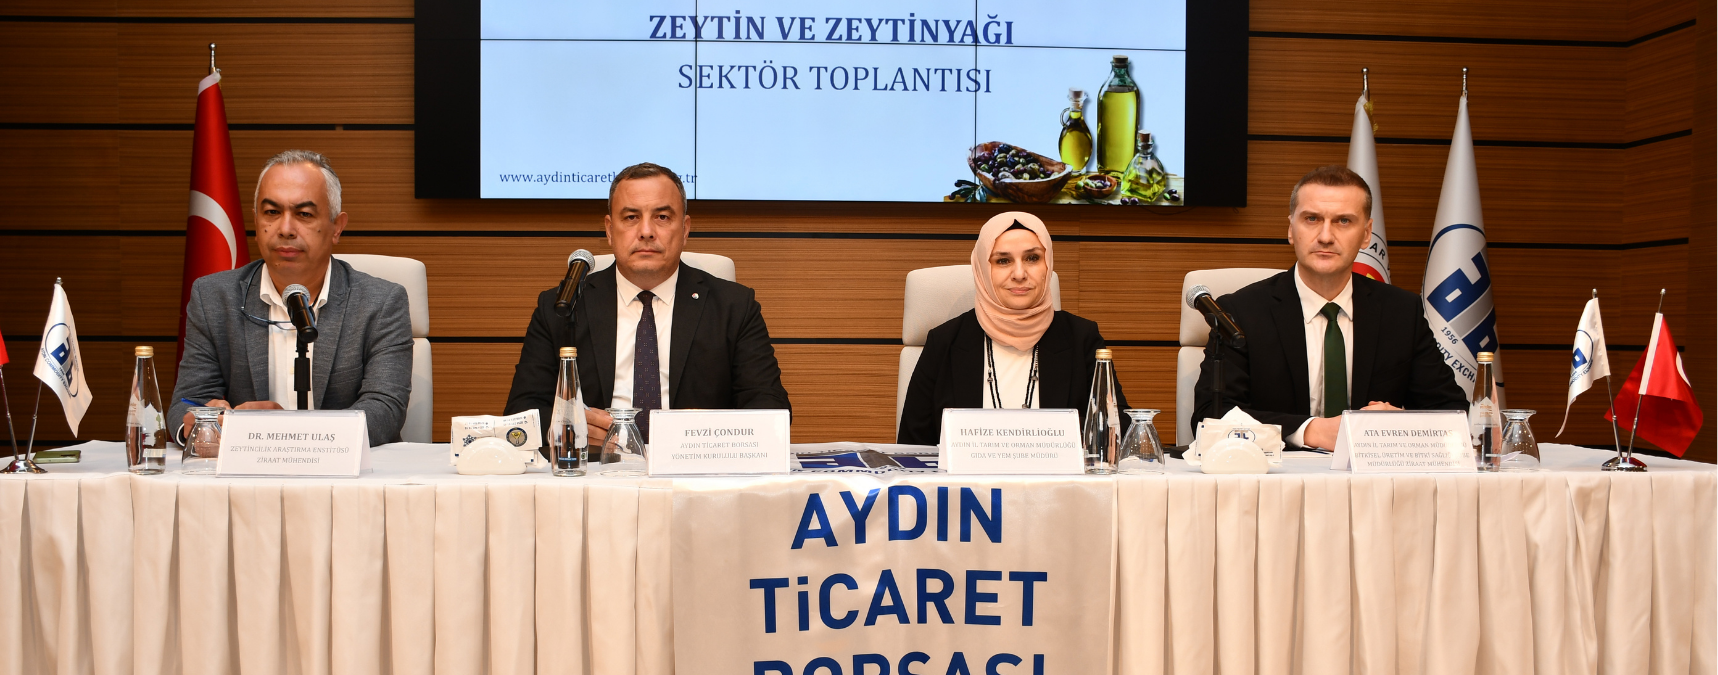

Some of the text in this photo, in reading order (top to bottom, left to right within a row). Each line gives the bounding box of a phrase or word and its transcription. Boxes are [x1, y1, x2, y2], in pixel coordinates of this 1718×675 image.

[649, 10, 1014, 45] ZEYTİN VE ZEYTİNYAĞI
[678, 60, 992, 93] SEKTÖR TOPLANTISI
[1440, 326, 1459, 345] 1956
[248, 432, 336, 442] DR. MEHMET ULAŞ
[684, 427, 755, 438] FEVZİ ÇONDUR
[960, 427, 1065, 437] HAFİZE KENDİRLİOĞLU
[1363, 429, 1380, 437] ATA
[1381, 429, 1409, 437] EVREN
[230, 445, 272, 453] ZEYTİNCİLİK
[272, 446, 312, 454] ARAŞTIRMA
[702, 441, 731, 449] TİCARET
[256, 456, 321, 464] ZİRAAT MÜHENDİSİ
[671, 452, 702, 460] YÖNETİM
[739, 452, 768, 460] BAŞKANI
[790, 484, 1002, 550] AYDIN
